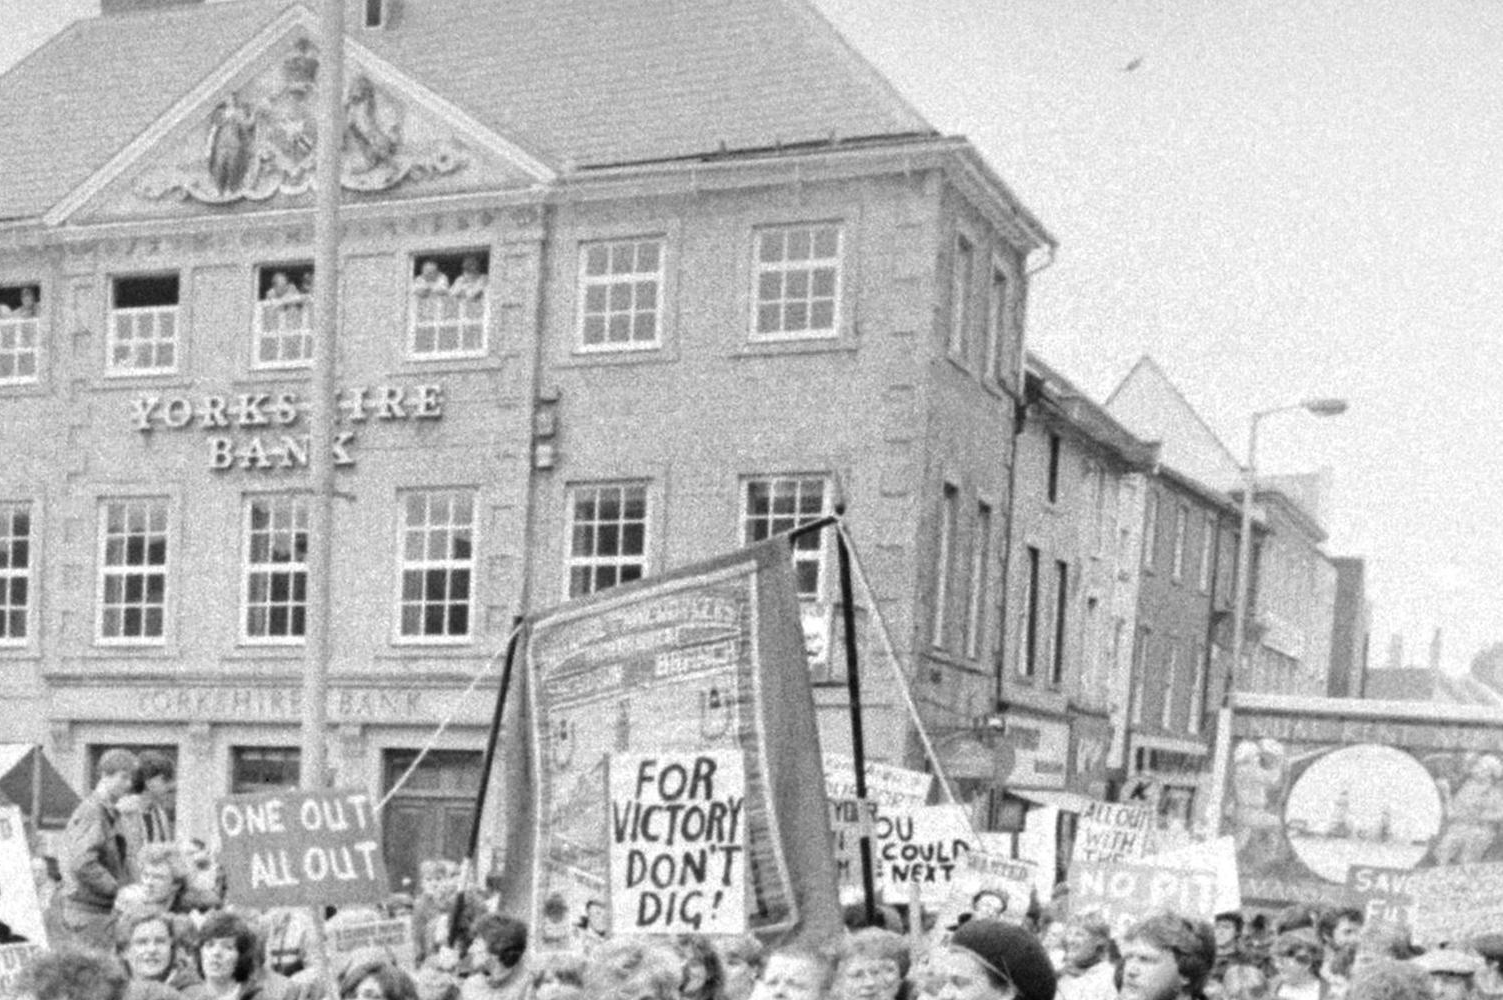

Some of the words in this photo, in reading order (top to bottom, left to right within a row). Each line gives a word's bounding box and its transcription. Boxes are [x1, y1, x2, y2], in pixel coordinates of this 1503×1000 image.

[131, 384, 443, 432] YORKSIRE
[209, 433, 357, 471] BANK
[636, 757, 718, 801] FOR
[222, 803, 283, 836] ONE
[302, 793, 374, 830] OUT
[612, 797, 743, 844] VICTORY
[875, 816, 914, 842] OU
[1085, 829, 1137, 852] WITH
[251, 852, 300, 889] ALL
[304, 841, 379, 882] OUT
[627, 846, 742, 889] DON'T
[892, 864, 955, 883] NEXT
[1078, 869, 1134, 897] NO
[637, 891, 724, 931] DIG!
